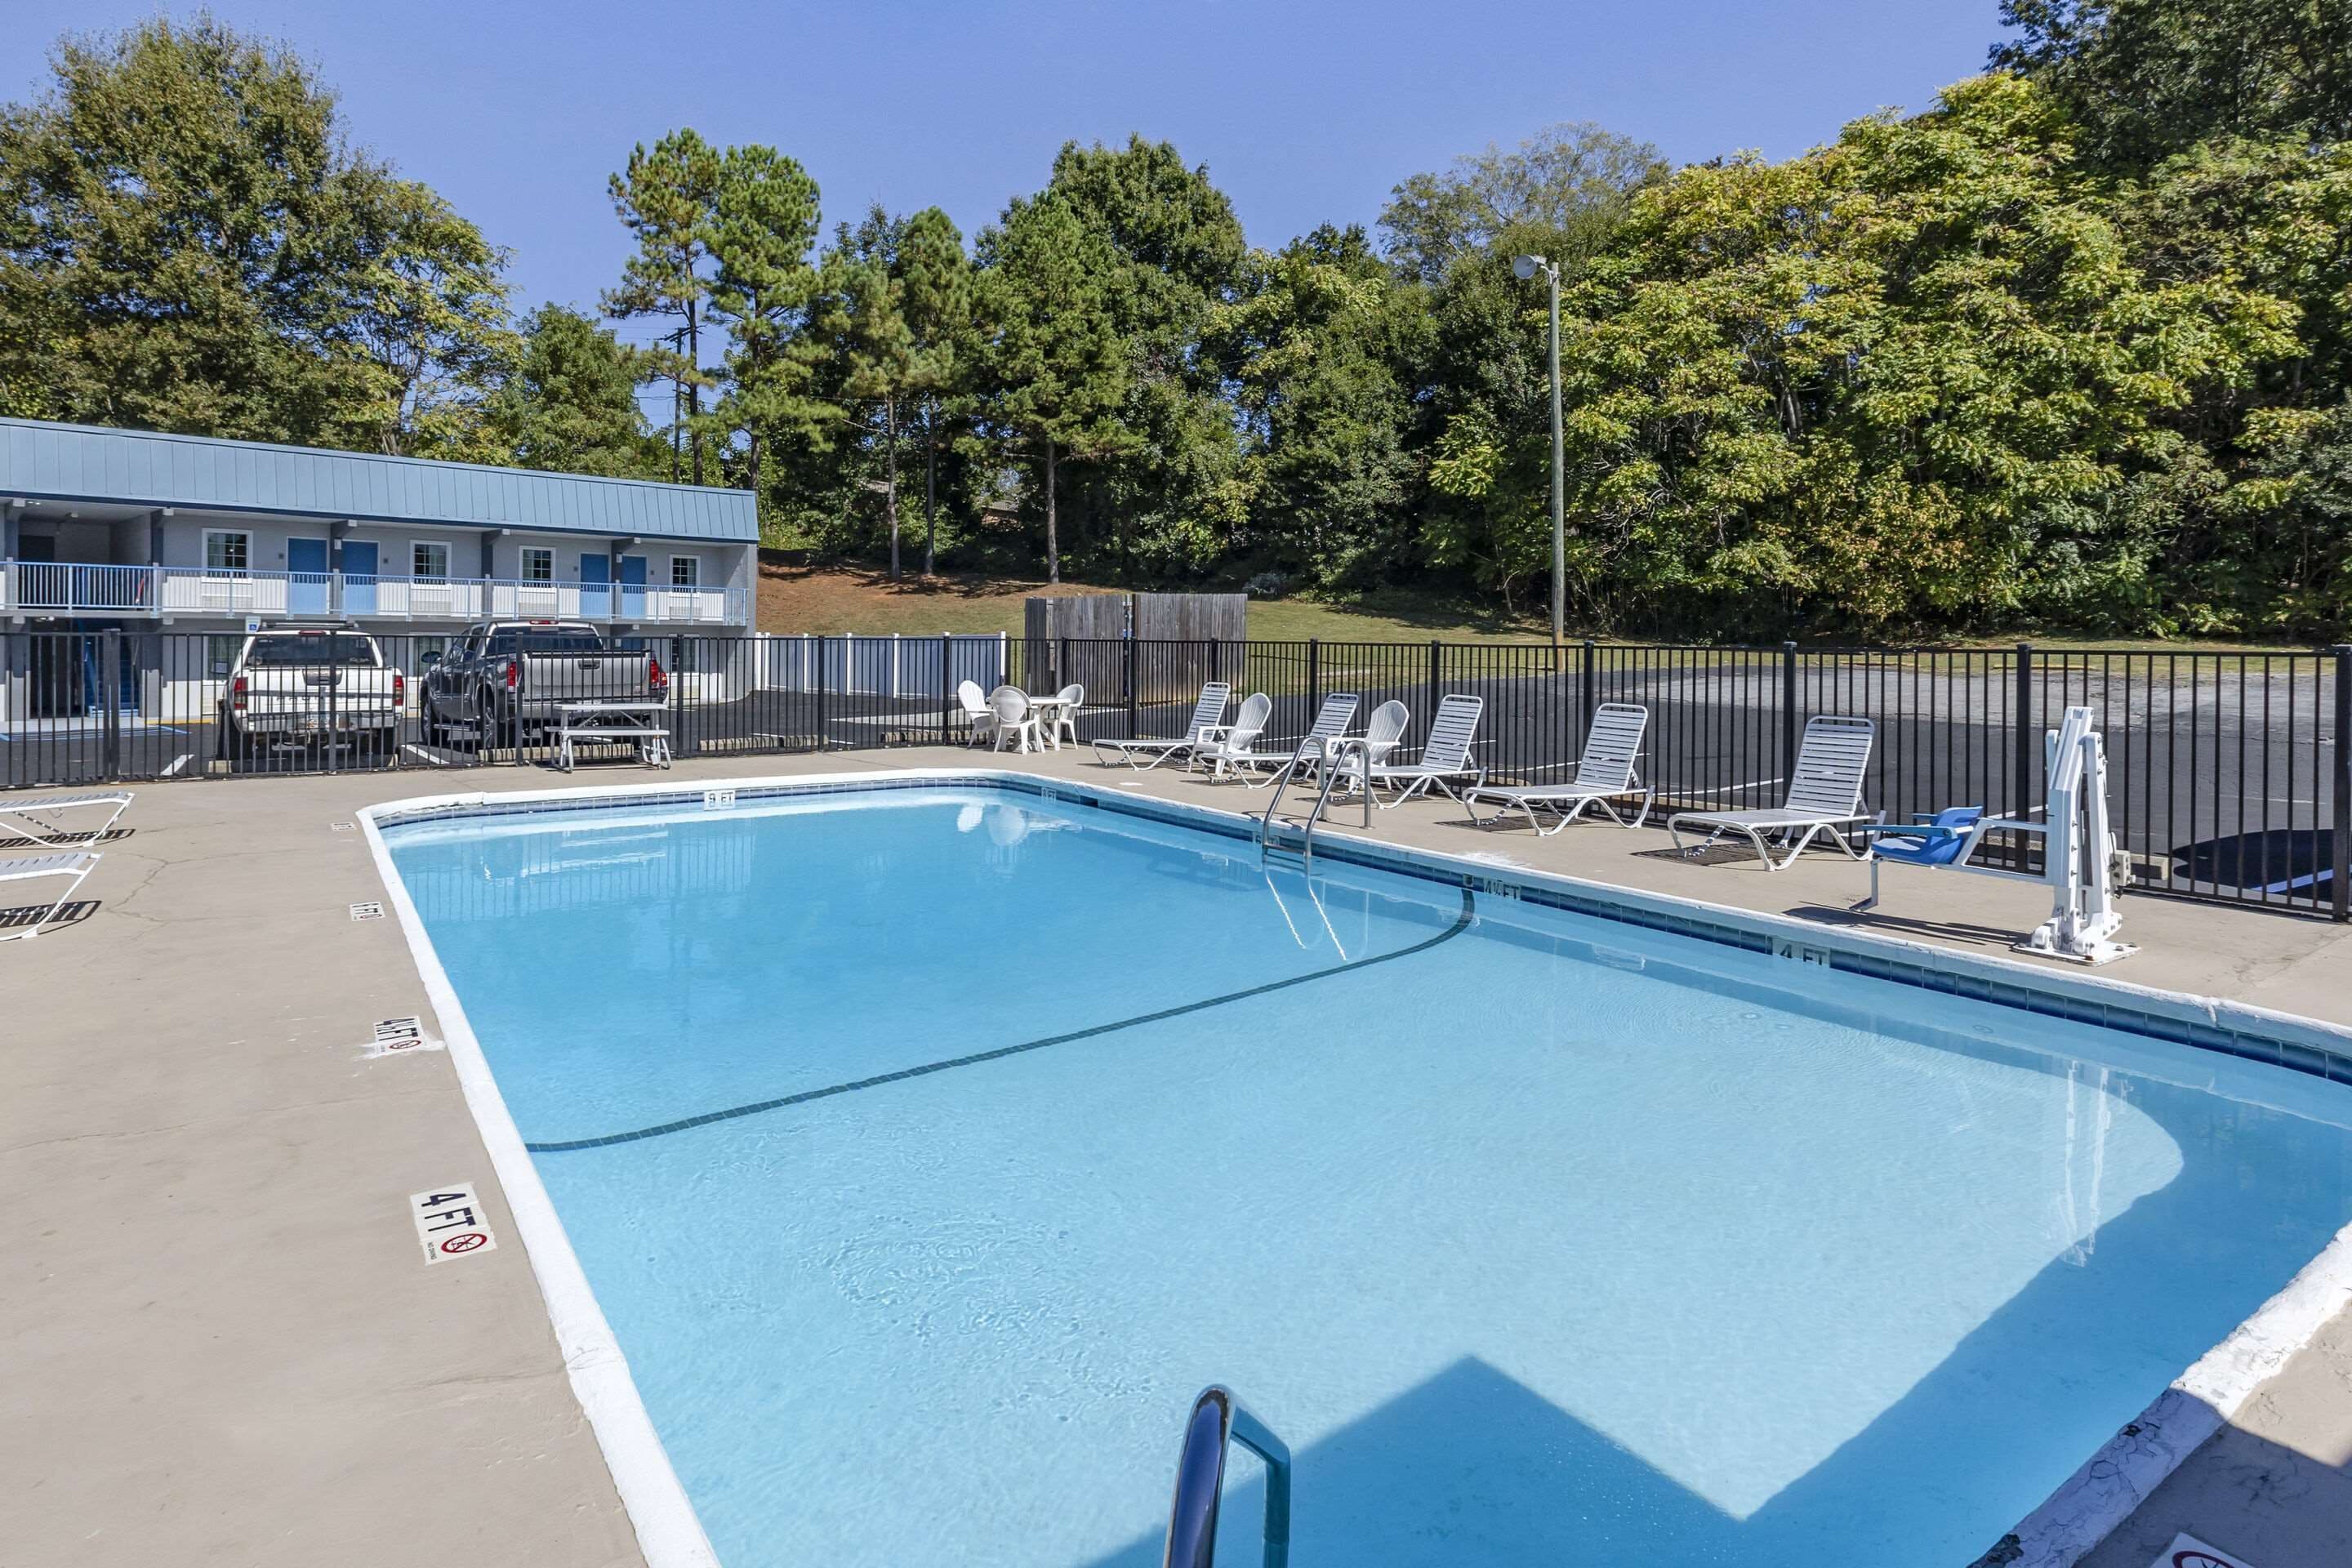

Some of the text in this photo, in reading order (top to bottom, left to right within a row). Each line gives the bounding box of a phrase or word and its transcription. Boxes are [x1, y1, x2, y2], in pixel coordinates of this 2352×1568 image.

[1780, 943, 1828, 966] 4 FT
[421, 1192, 476, 1232] 4 FT
